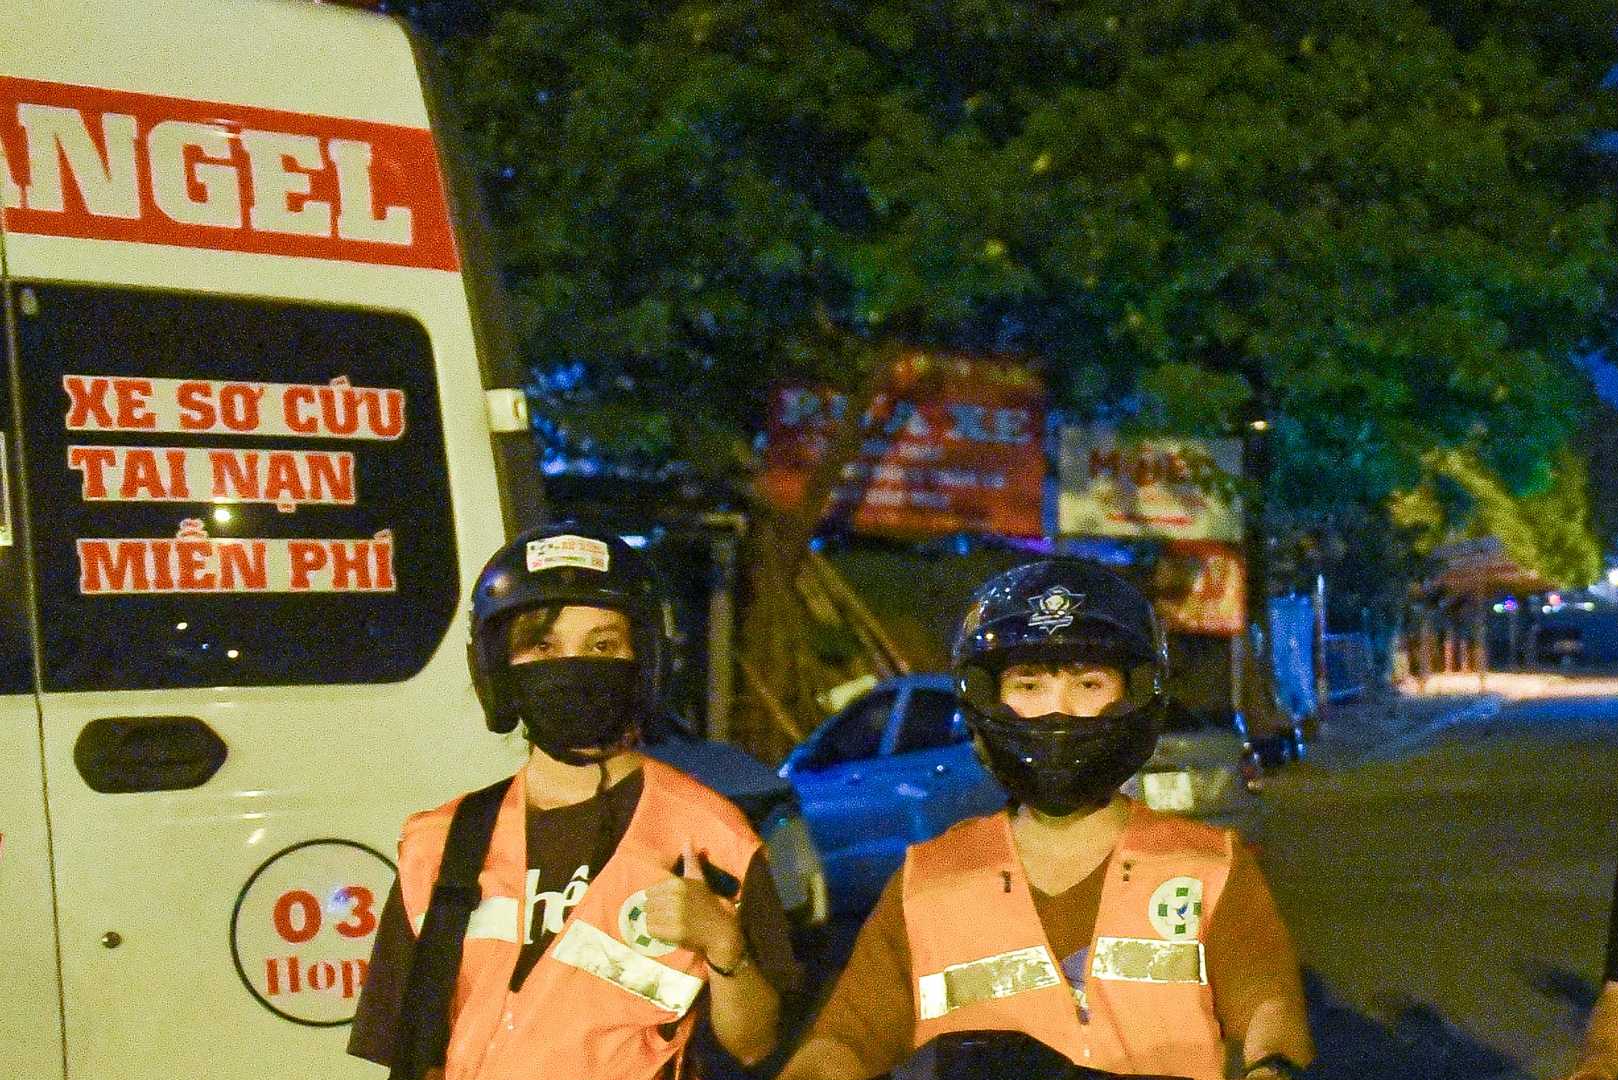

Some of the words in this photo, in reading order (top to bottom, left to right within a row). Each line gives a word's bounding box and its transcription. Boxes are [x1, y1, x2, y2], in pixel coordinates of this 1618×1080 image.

[65, 377, 156, 429] XE
[177, 382, 263, 431] SƠ
[283, 378, 402, 437] CỨU
[70, 449, 189, 498] TAI
[209, 451, 352, 509] NẠN
[80, 519, 267, 590] MIỄN
[288, 532, 394, 590] PHÍ
